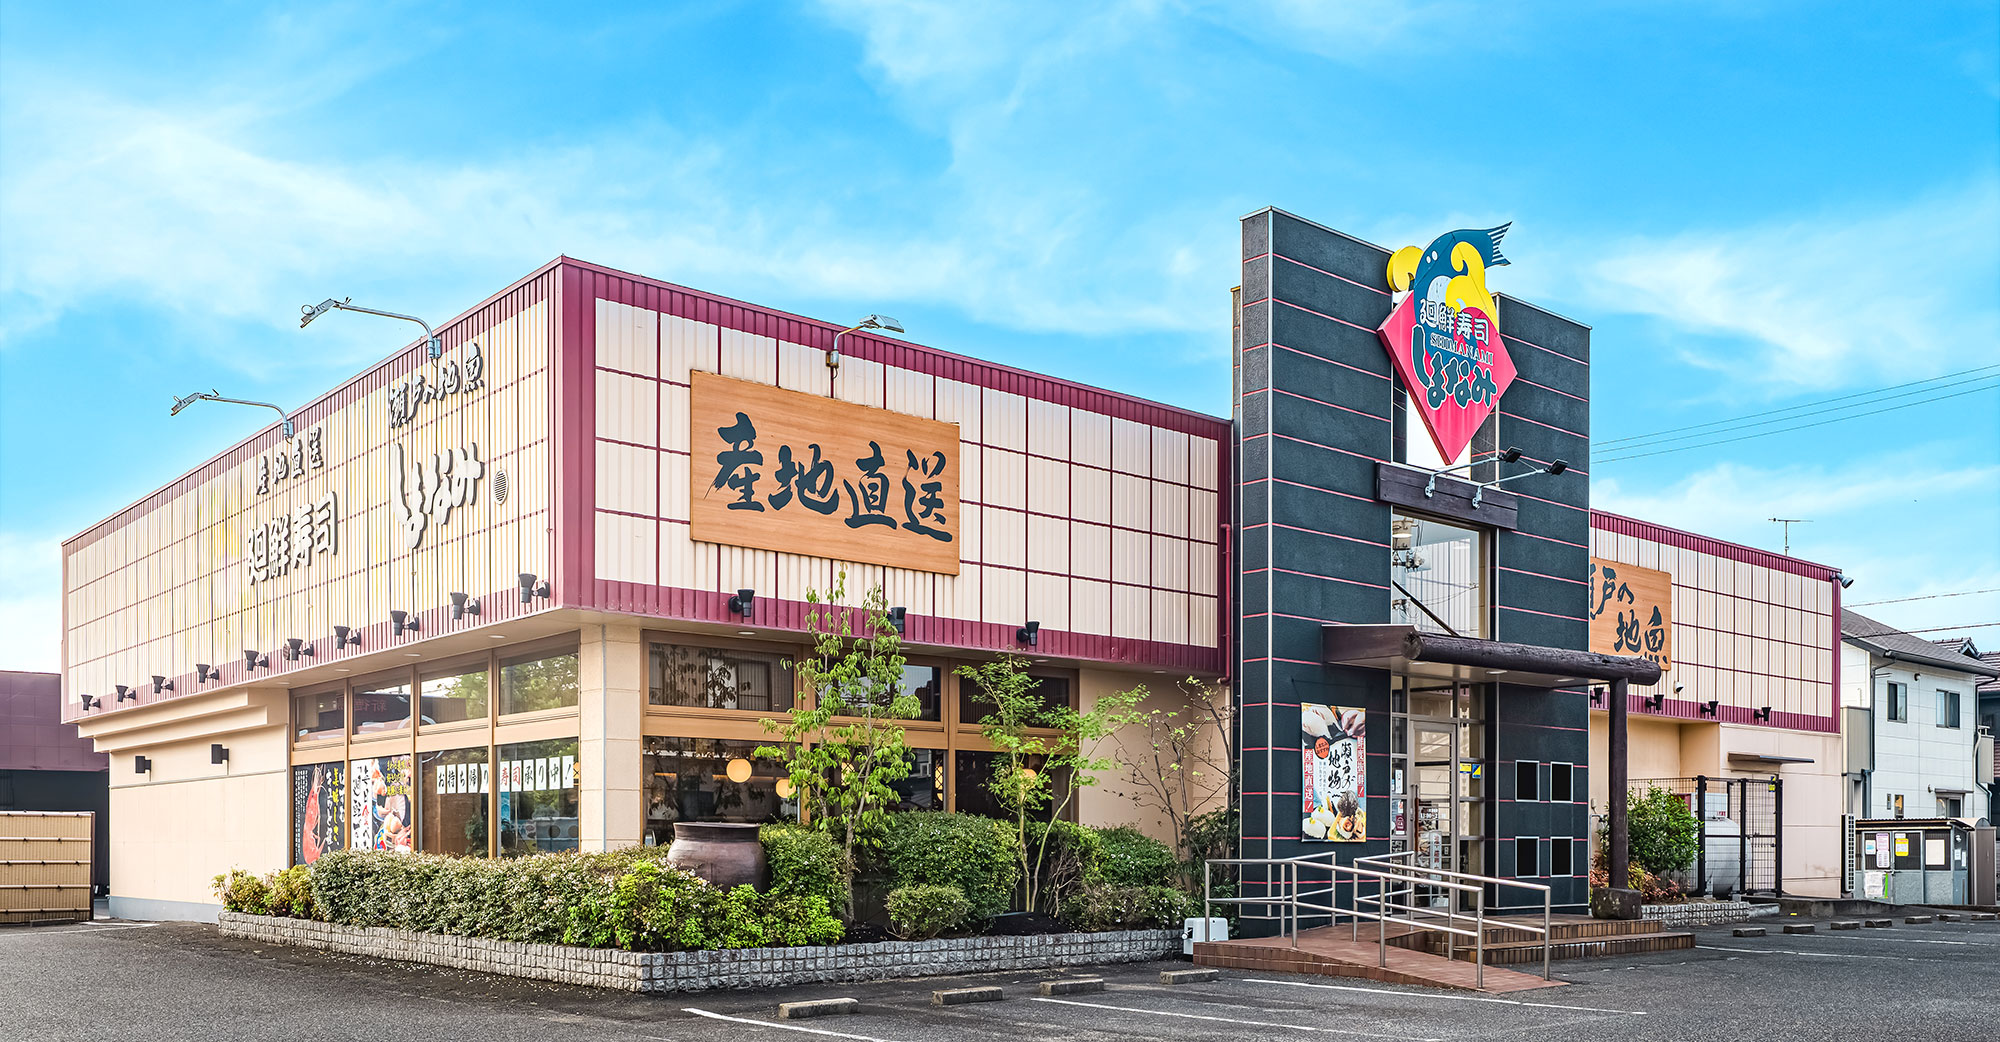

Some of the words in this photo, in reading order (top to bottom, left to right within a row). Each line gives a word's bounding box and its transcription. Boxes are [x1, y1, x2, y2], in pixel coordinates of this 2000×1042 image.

[1420, 299, 1490, 346] 廻鮮寿司
[1430, 332, 1494, 366] SHIMANAMI
[1411, 324, 1498, 410] しまなみ
[256, 427, 324, 495] 産地直送
[391, 441, 485, 550] しまなみ
[703, 411, 953, 543] 産地直送
[247, 490, 339, 586] 廻鮮寿司
[438, 767, 488, 788] お持ち帰り
[500, 763, 572, 786] 寿司承り中!
